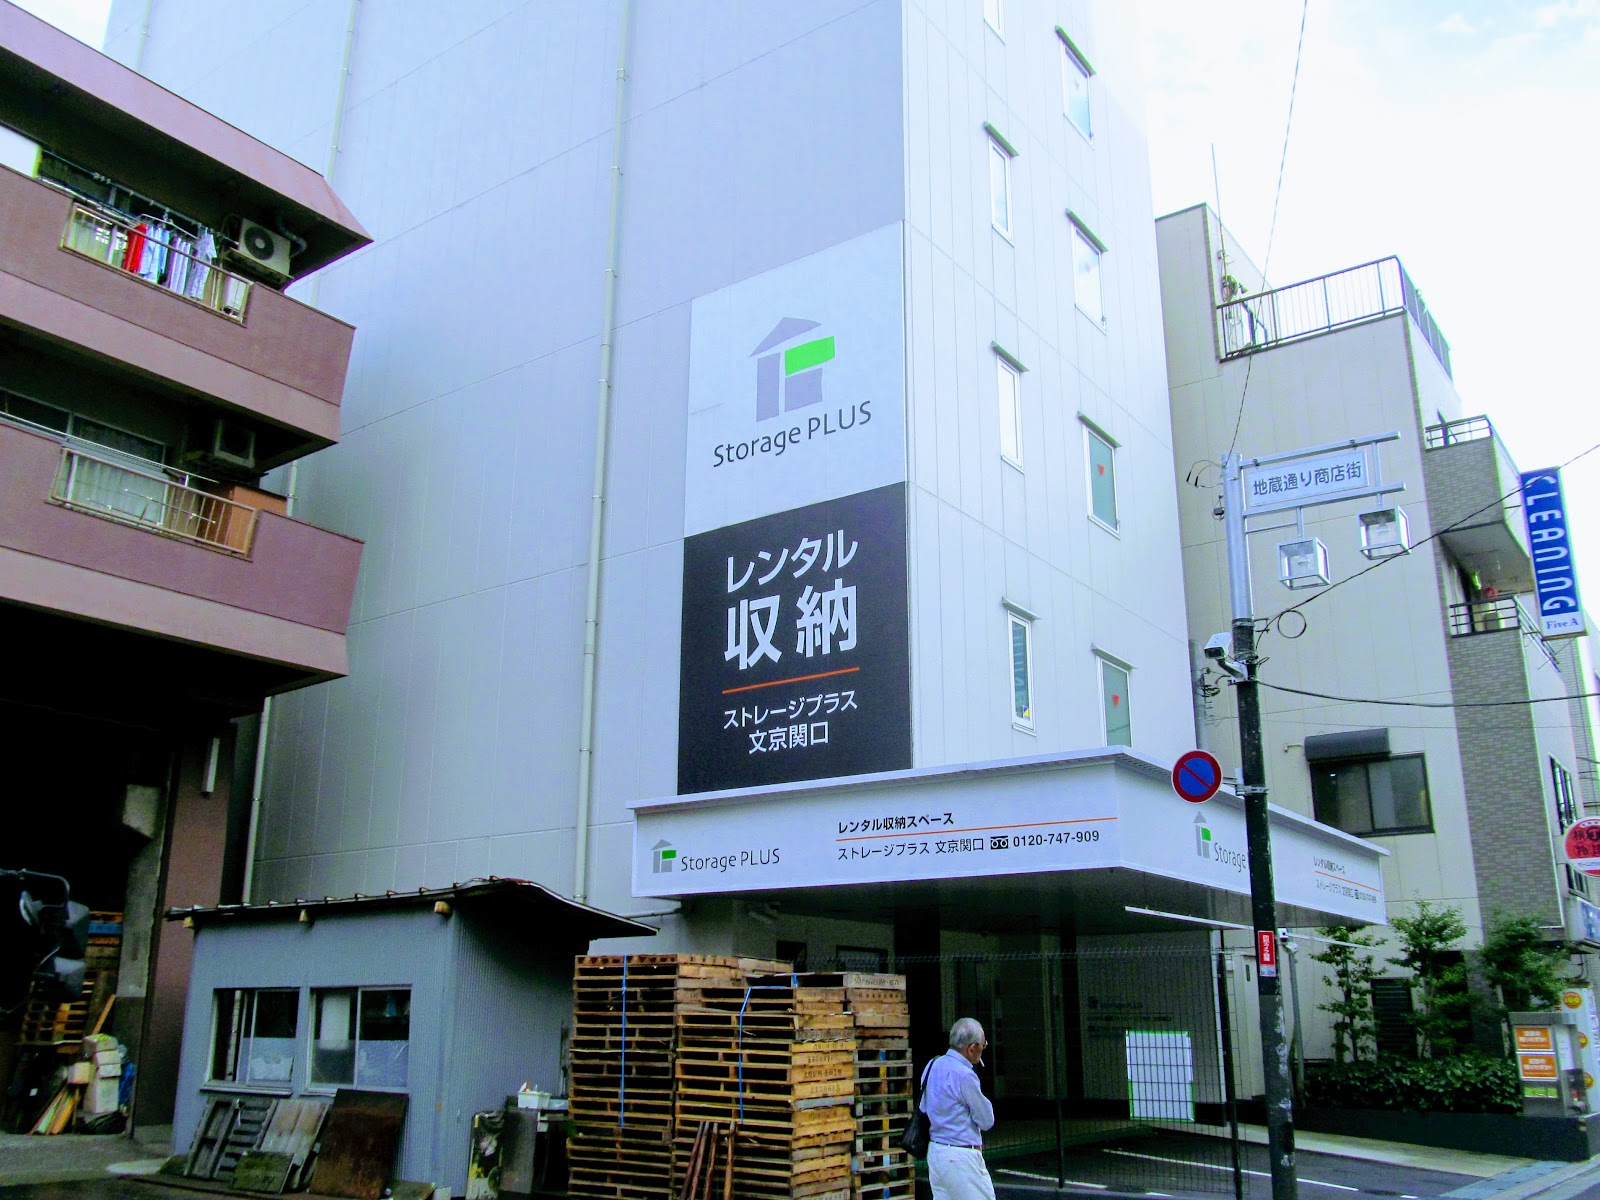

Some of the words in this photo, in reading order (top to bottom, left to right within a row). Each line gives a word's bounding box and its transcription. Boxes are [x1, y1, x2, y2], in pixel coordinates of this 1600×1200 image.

[713, 427, 801, 467] Storage
[808, 400, 872, 440] PLUS
[1253, 461, 1361, 496] 地蔵通り商店街
[1525, 475, 1576, 611] CLEANING
[727, 529, 859, 593] レンタル
[724, 578, 857, 670] 収納
[1546, 620, 1568, 630] Five
[1570, 618, 1580, 627] A
[723, 690, 858, 729] ストレージプラス
[748, 721, 829, 755] 文京関口
[838, 812, 955, 834] レンタル収納スペース
[681, 854, 737, 872] Storage
[740, 848, 780, 867] PLUS
[838, 842, 931, 860] ストレージプラス
[935, 838, 984, 855] 文京関口
[1013, 830, 1100, 848] 0120-747-909
[1214, 842, 1246, 873] Storage
